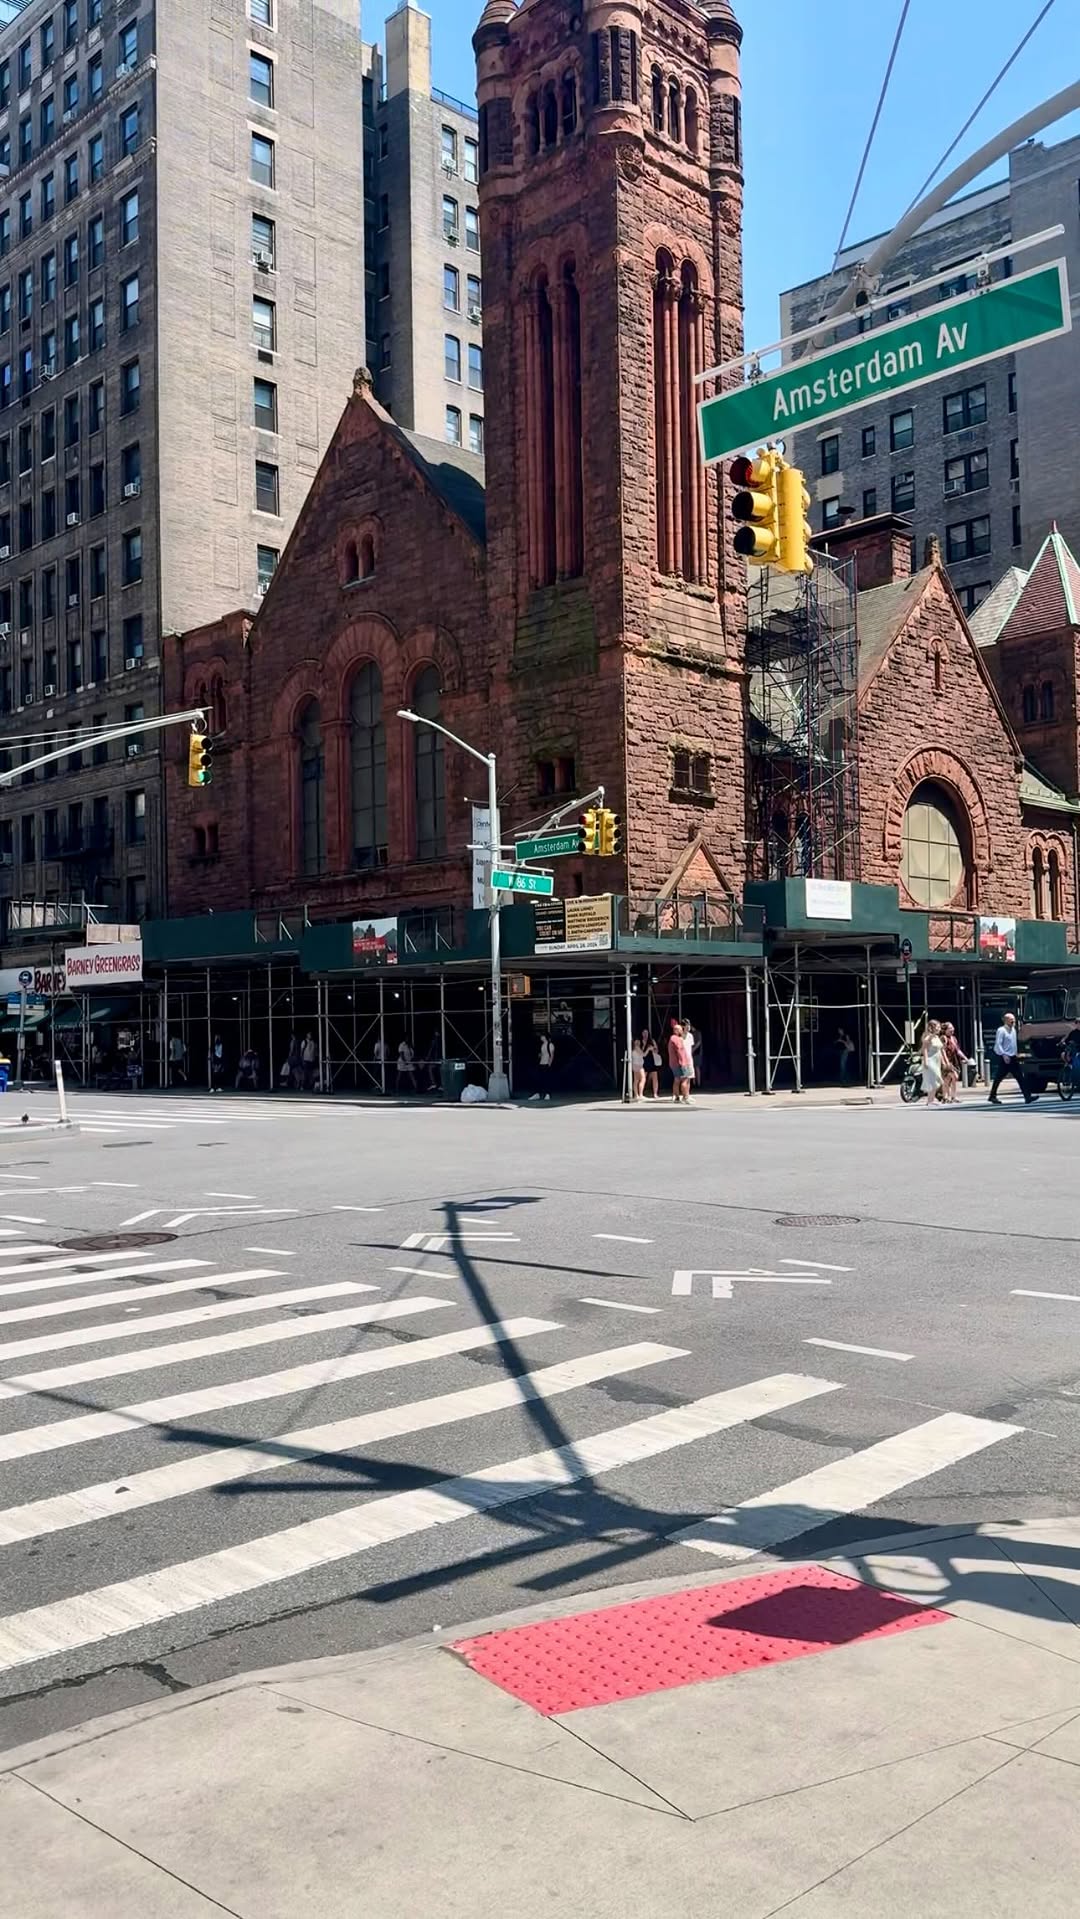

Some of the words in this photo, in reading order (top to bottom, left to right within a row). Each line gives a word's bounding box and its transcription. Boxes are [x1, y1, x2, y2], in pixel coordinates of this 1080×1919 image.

[773, 340, 923, 421] Amsterdam
[936, 321, 968, 358] Av
[534, 841, 570, 853] Amsterdam
[516, 877, 526, 888] 86
[529, 879, 536, 889] St
[67, 956, 94, 977] BARNEY
[94, 954, 140, 974] GREENGRASS
